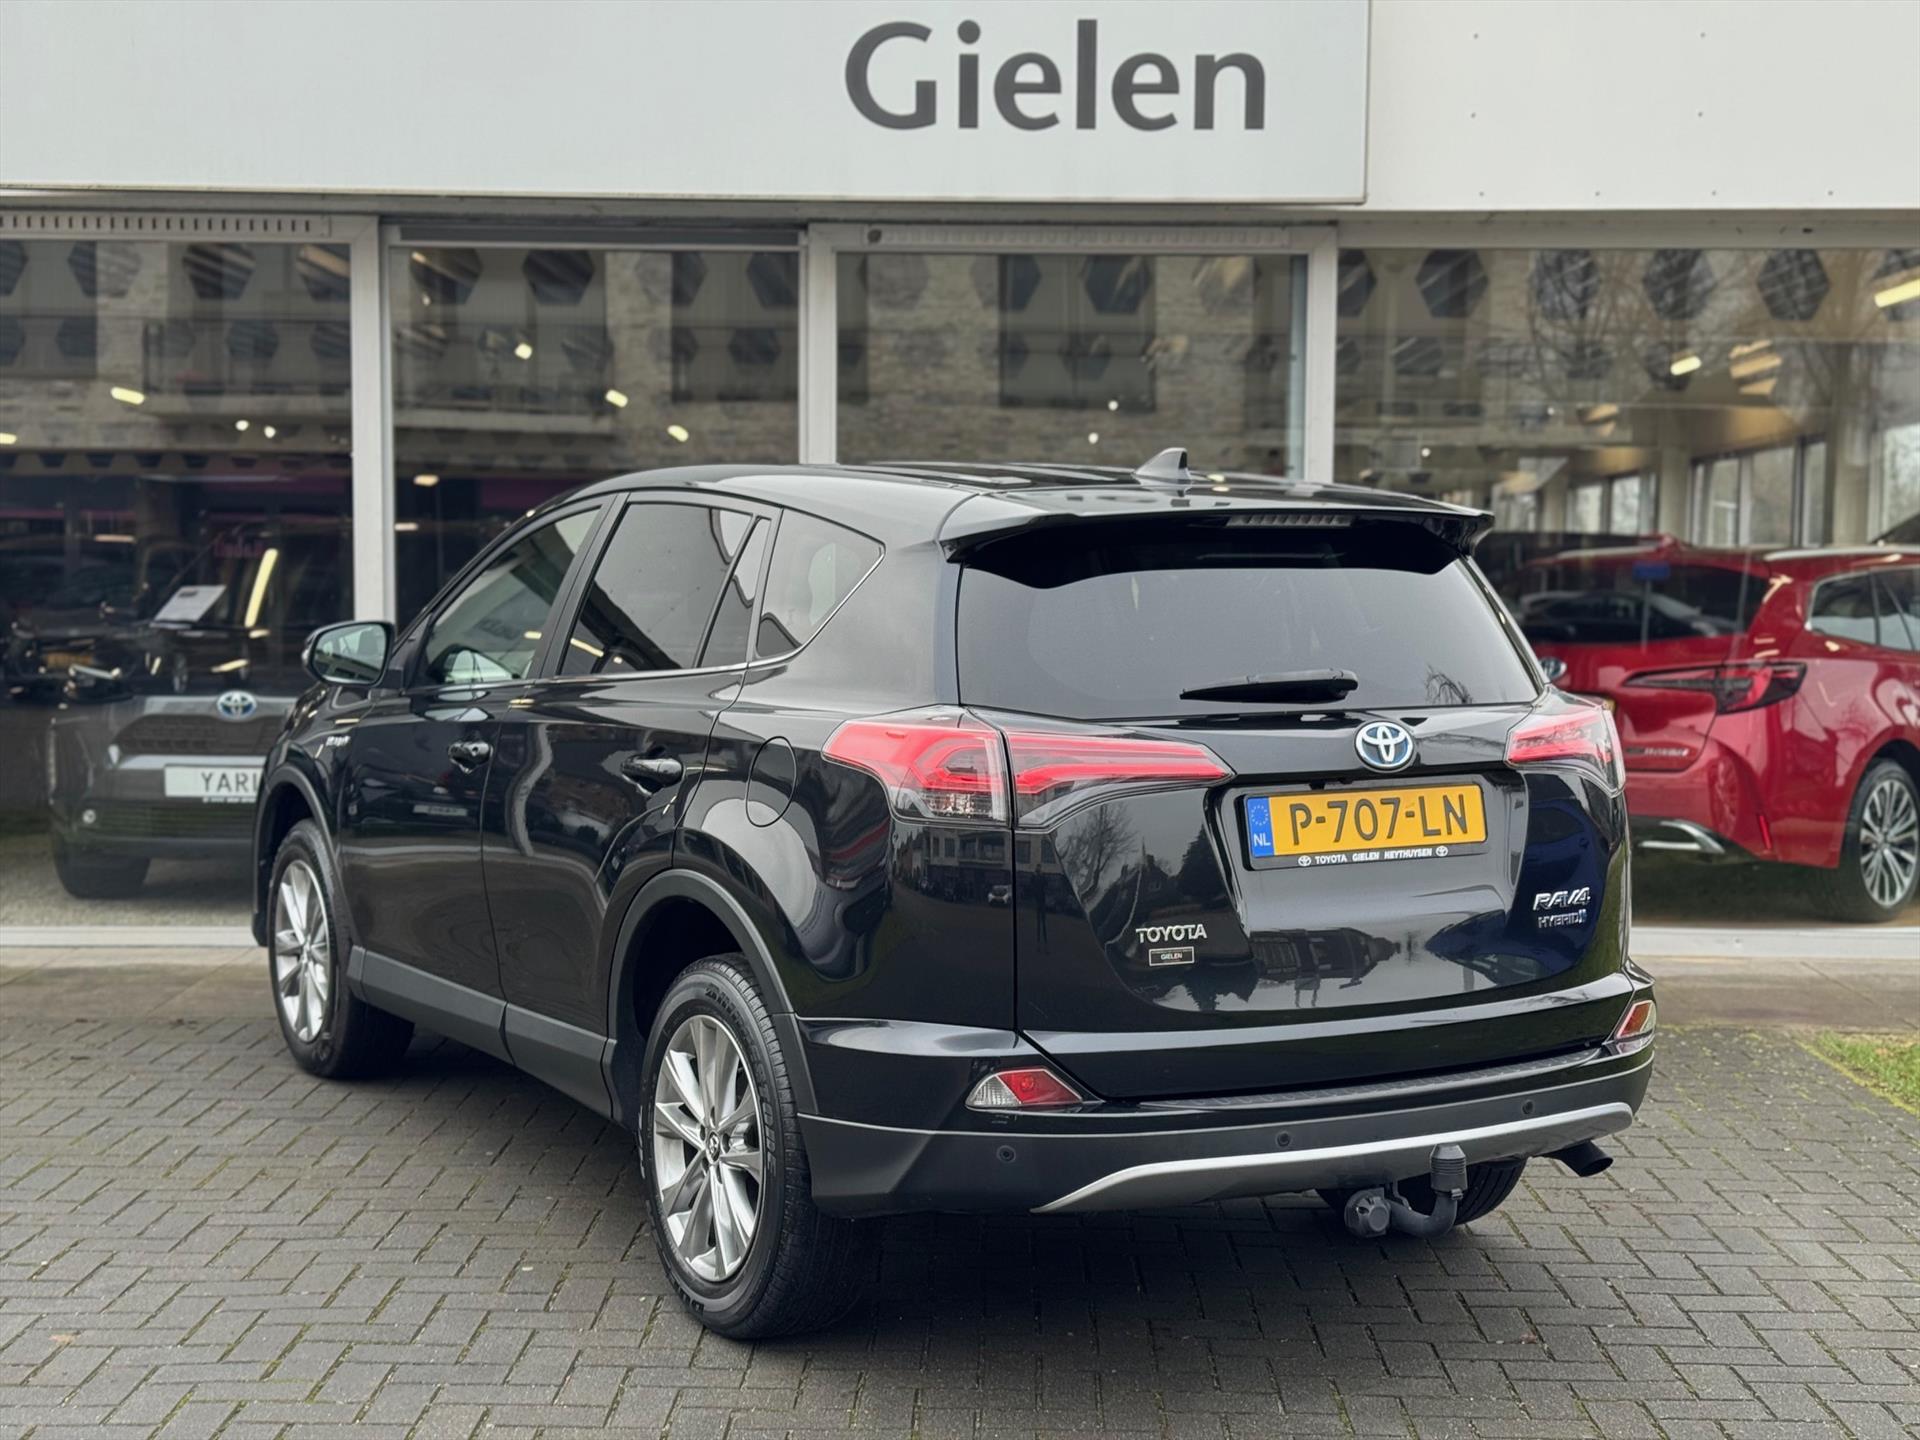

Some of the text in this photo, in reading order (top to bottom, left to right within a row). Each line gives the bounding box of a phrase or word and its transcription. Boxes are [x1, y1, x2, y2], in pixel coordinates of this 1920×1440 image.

[845, 19, 1266, 131] Gielen
[1289, 794, 1468, 846] P-707-LN
[1253, 833, 1271, 846] NL
[1315, 847, 1433, 865] TOYOTA GIELEN HEYTHUYSEN
[1532, 887, 1591, 911] RAV4
[1136, 923, 1208, 944] TOYOTA
